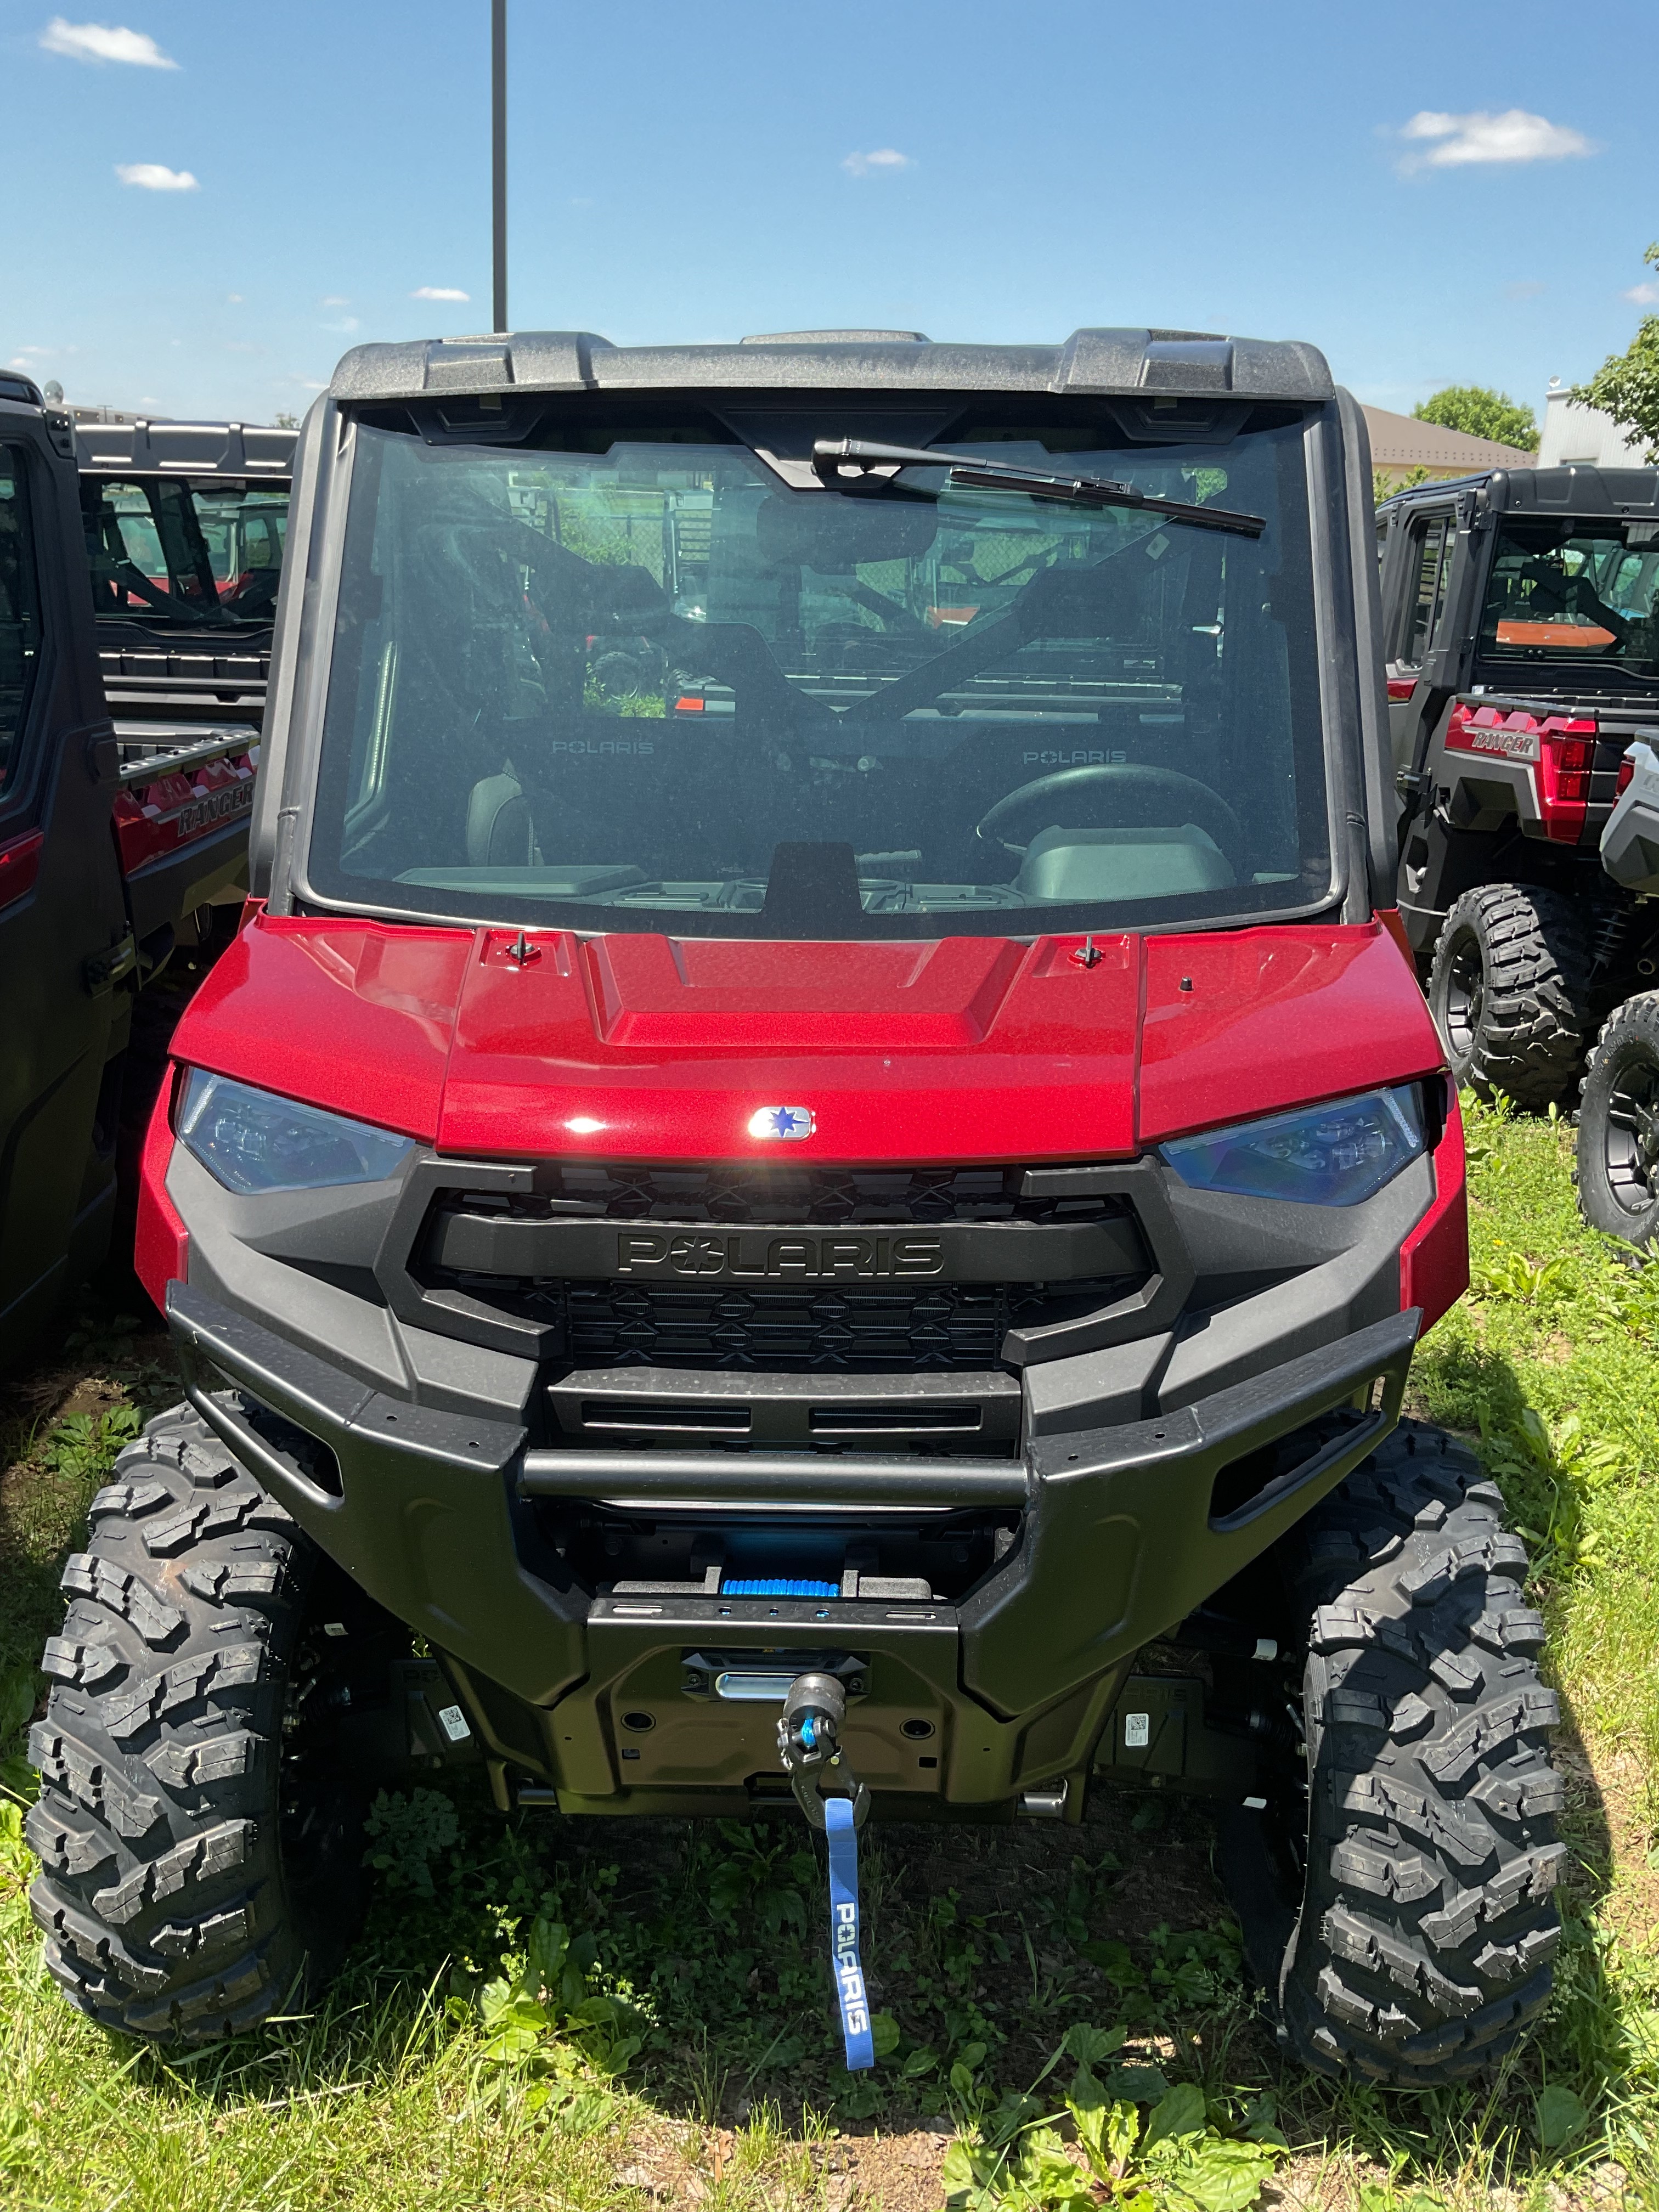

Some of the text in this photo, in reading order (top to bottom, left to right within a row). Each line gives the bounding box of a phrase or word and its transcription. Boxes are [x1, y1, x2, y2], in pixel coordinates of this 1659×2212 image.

[552, 741, 654, 754] POLARIS
[1023, 750, 1127, 764] POLARIS
[1472, 732, 1533, 755] RANGER
[178, 781, 254, 837] RANGER
[618, 1233, 944, 1275] POLARIS
[837, 1903, 867, 2035] POLARIS
